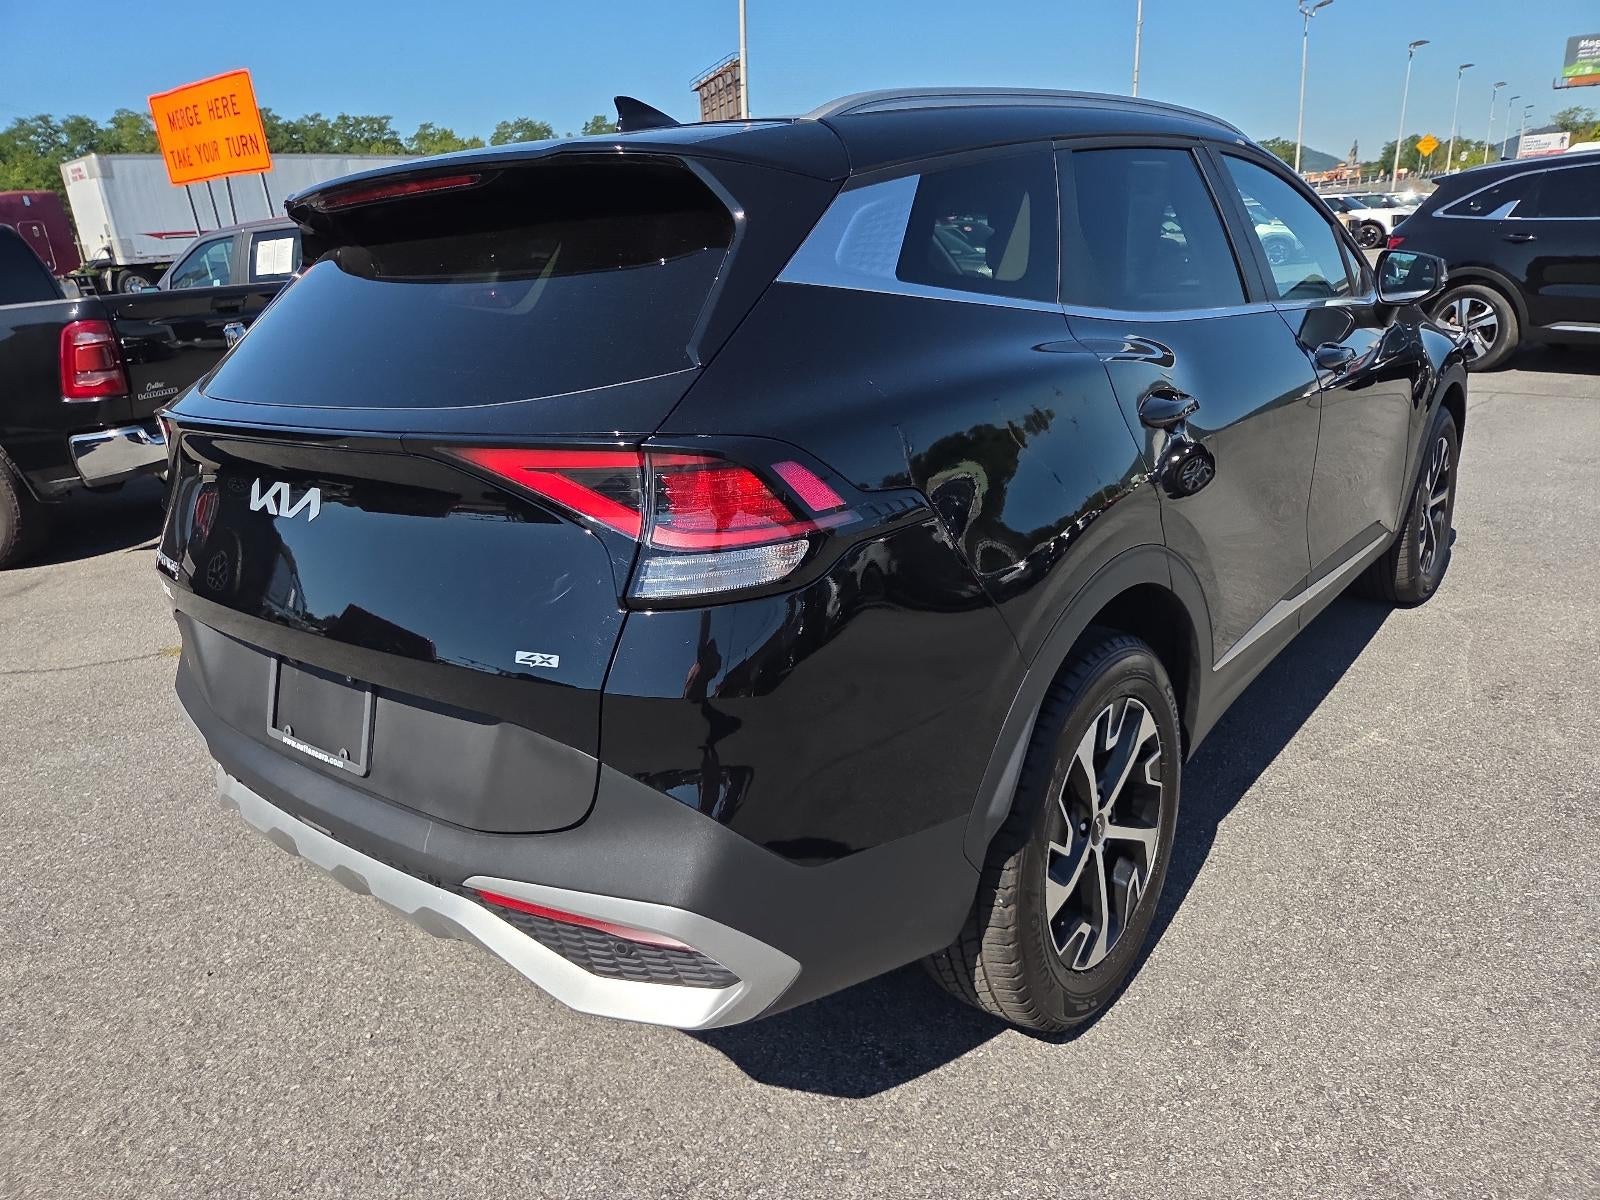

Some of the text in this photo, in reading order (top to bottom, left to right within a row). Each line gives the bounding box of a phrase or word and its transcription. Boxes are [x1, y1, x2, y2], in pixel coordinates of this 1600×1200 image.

[166, 93, 241, 133] MERGE HERE
[169, 133, 261, 170] TAKE YOUR TURN
[249, 477, 321, 522] KIA
